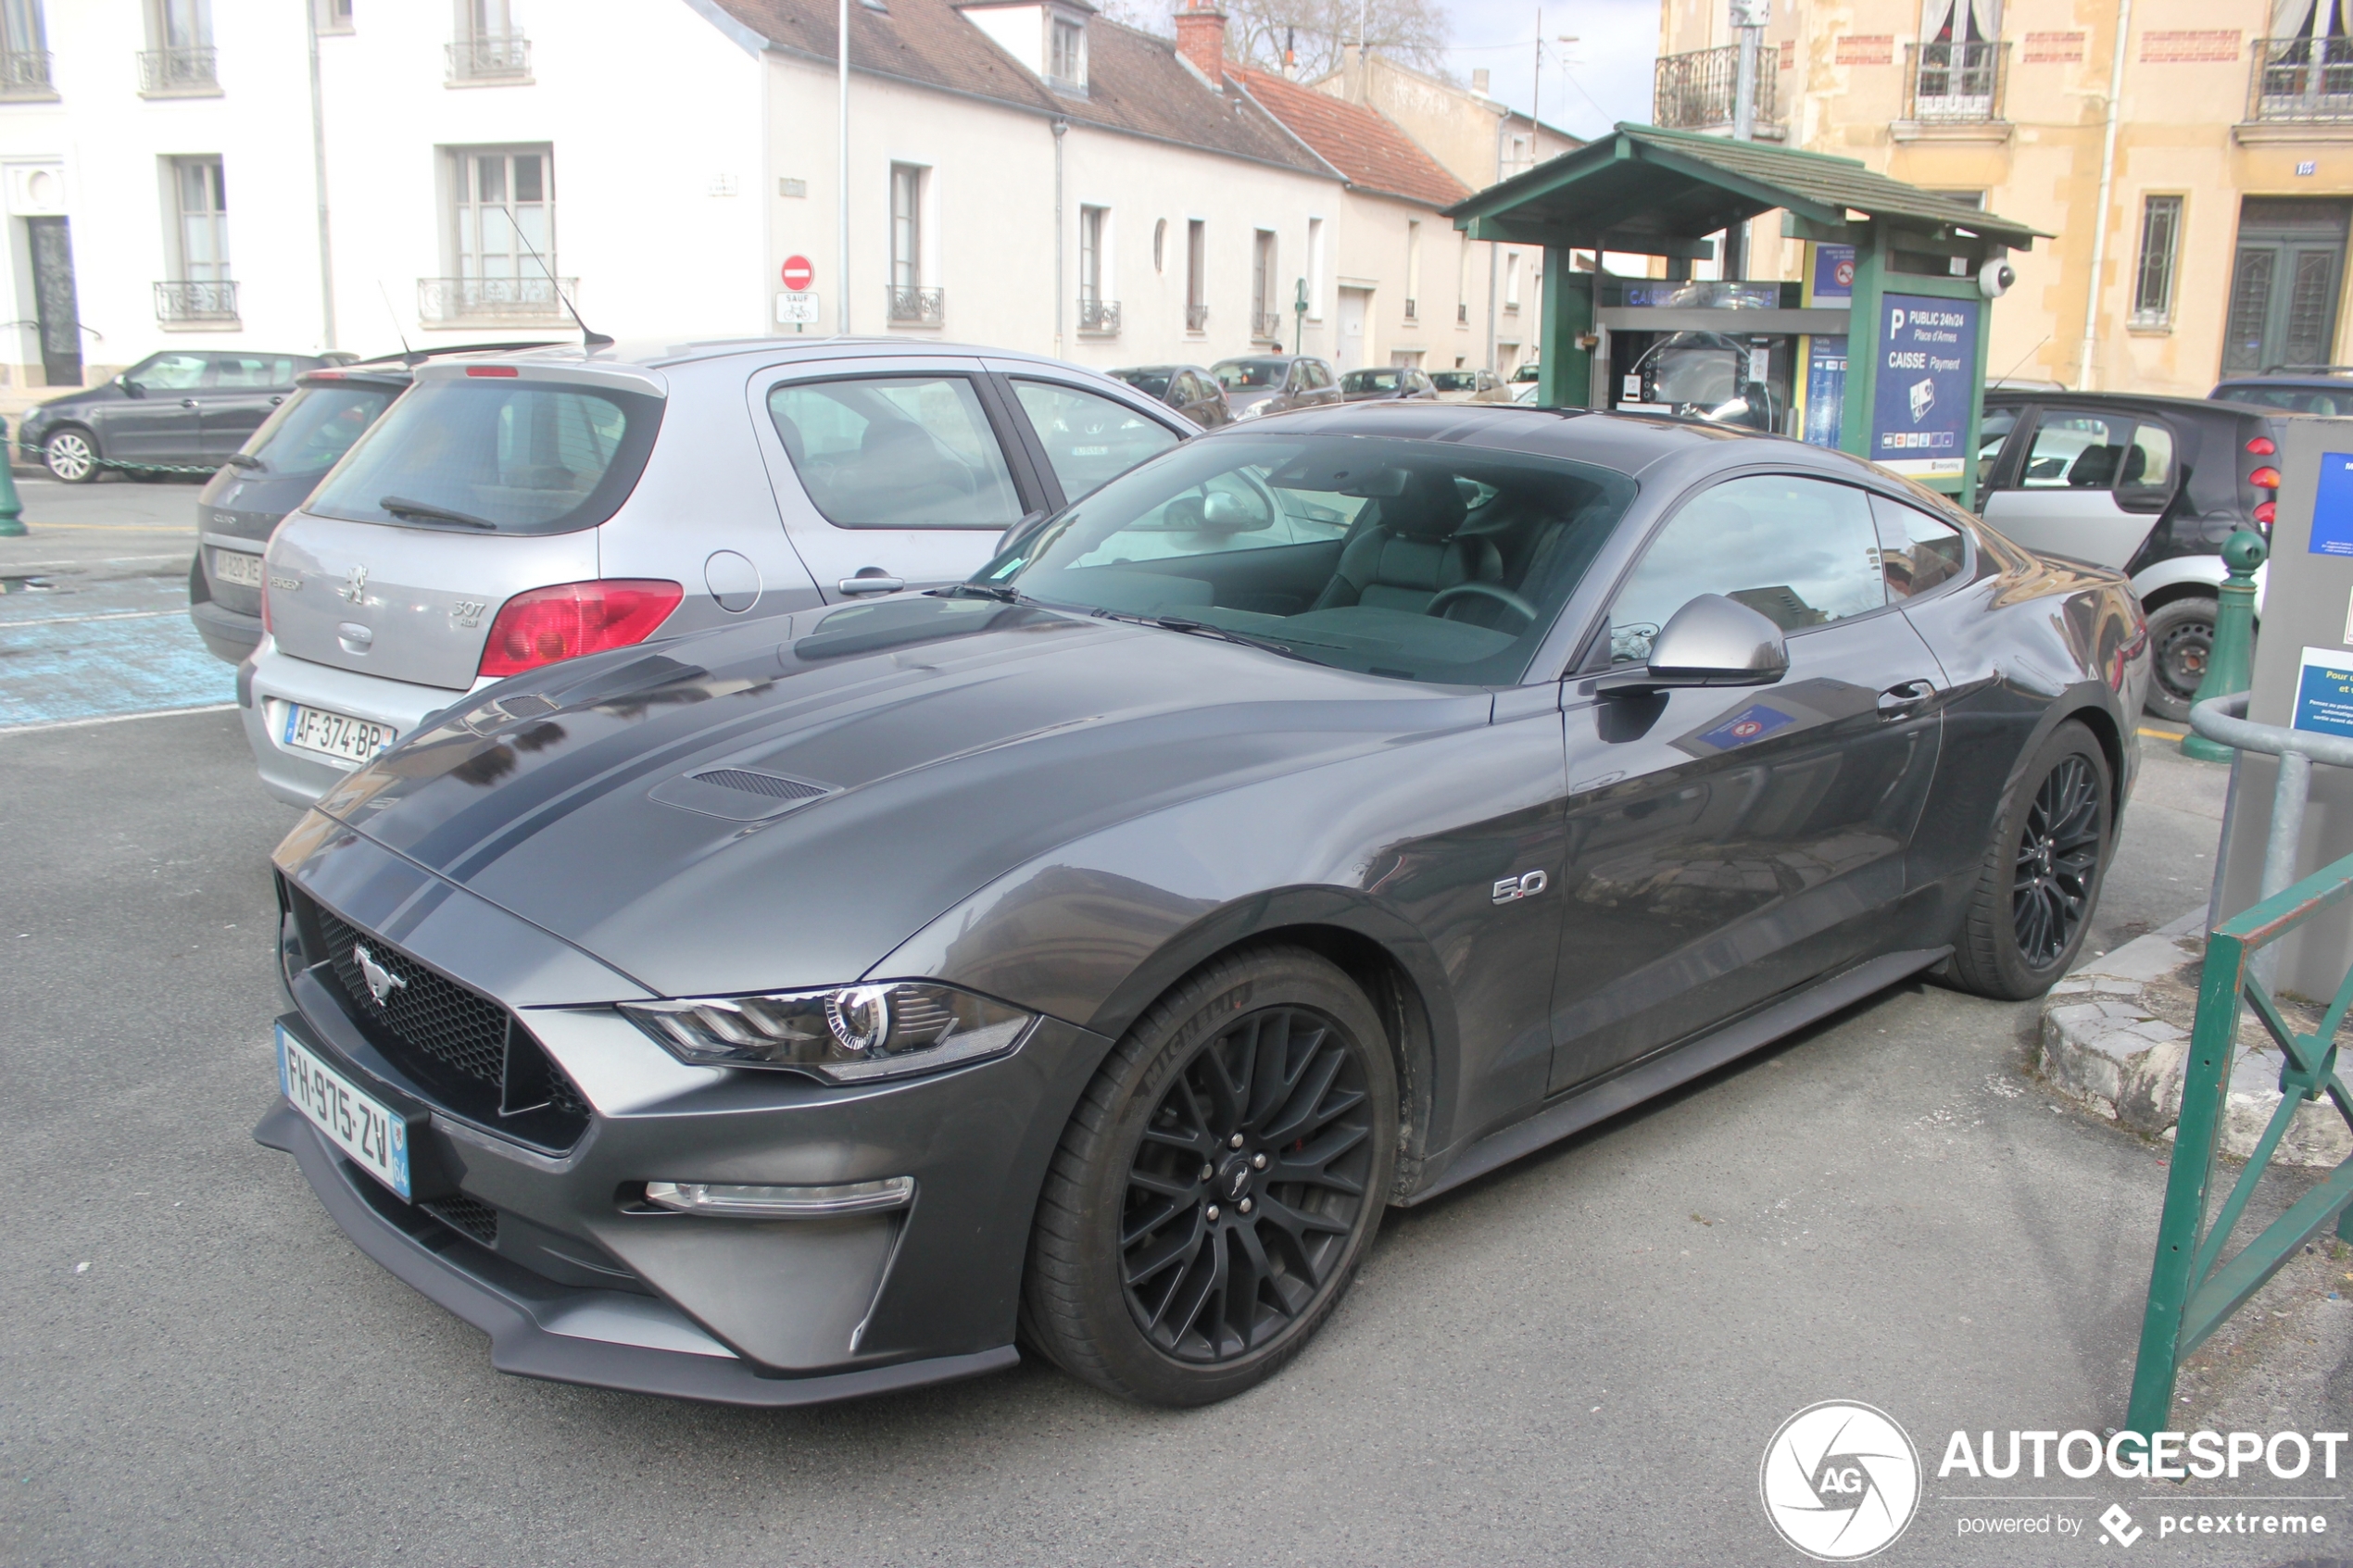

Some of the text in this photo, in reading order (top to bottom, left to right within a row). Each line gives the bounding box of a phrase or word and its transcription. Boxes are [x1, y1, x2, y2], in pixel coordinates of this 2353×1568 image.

[786, 294, 809, 303] SAUF
[1909, 310, 1965, 328] PUBLIC 24h/24
[1914, 329, 1957, 343] Place d'Armes
[1888, 352, 1961, 373] CAISSE Payment
[269, 575, 304, 592] PEUGEOT
[452, 600, 486, 618] 307
[2325, 671, 2348, 681] Pour
[2309, 698, 2329, 707] Pensez
[1491, 870, 1548, 906] 5.0
[1141, 984, 1249, 1091] MICHELIN
[287, 1045, 387, 1169] FH-975-ZV
[393, 1156, 408, 1188] 64
